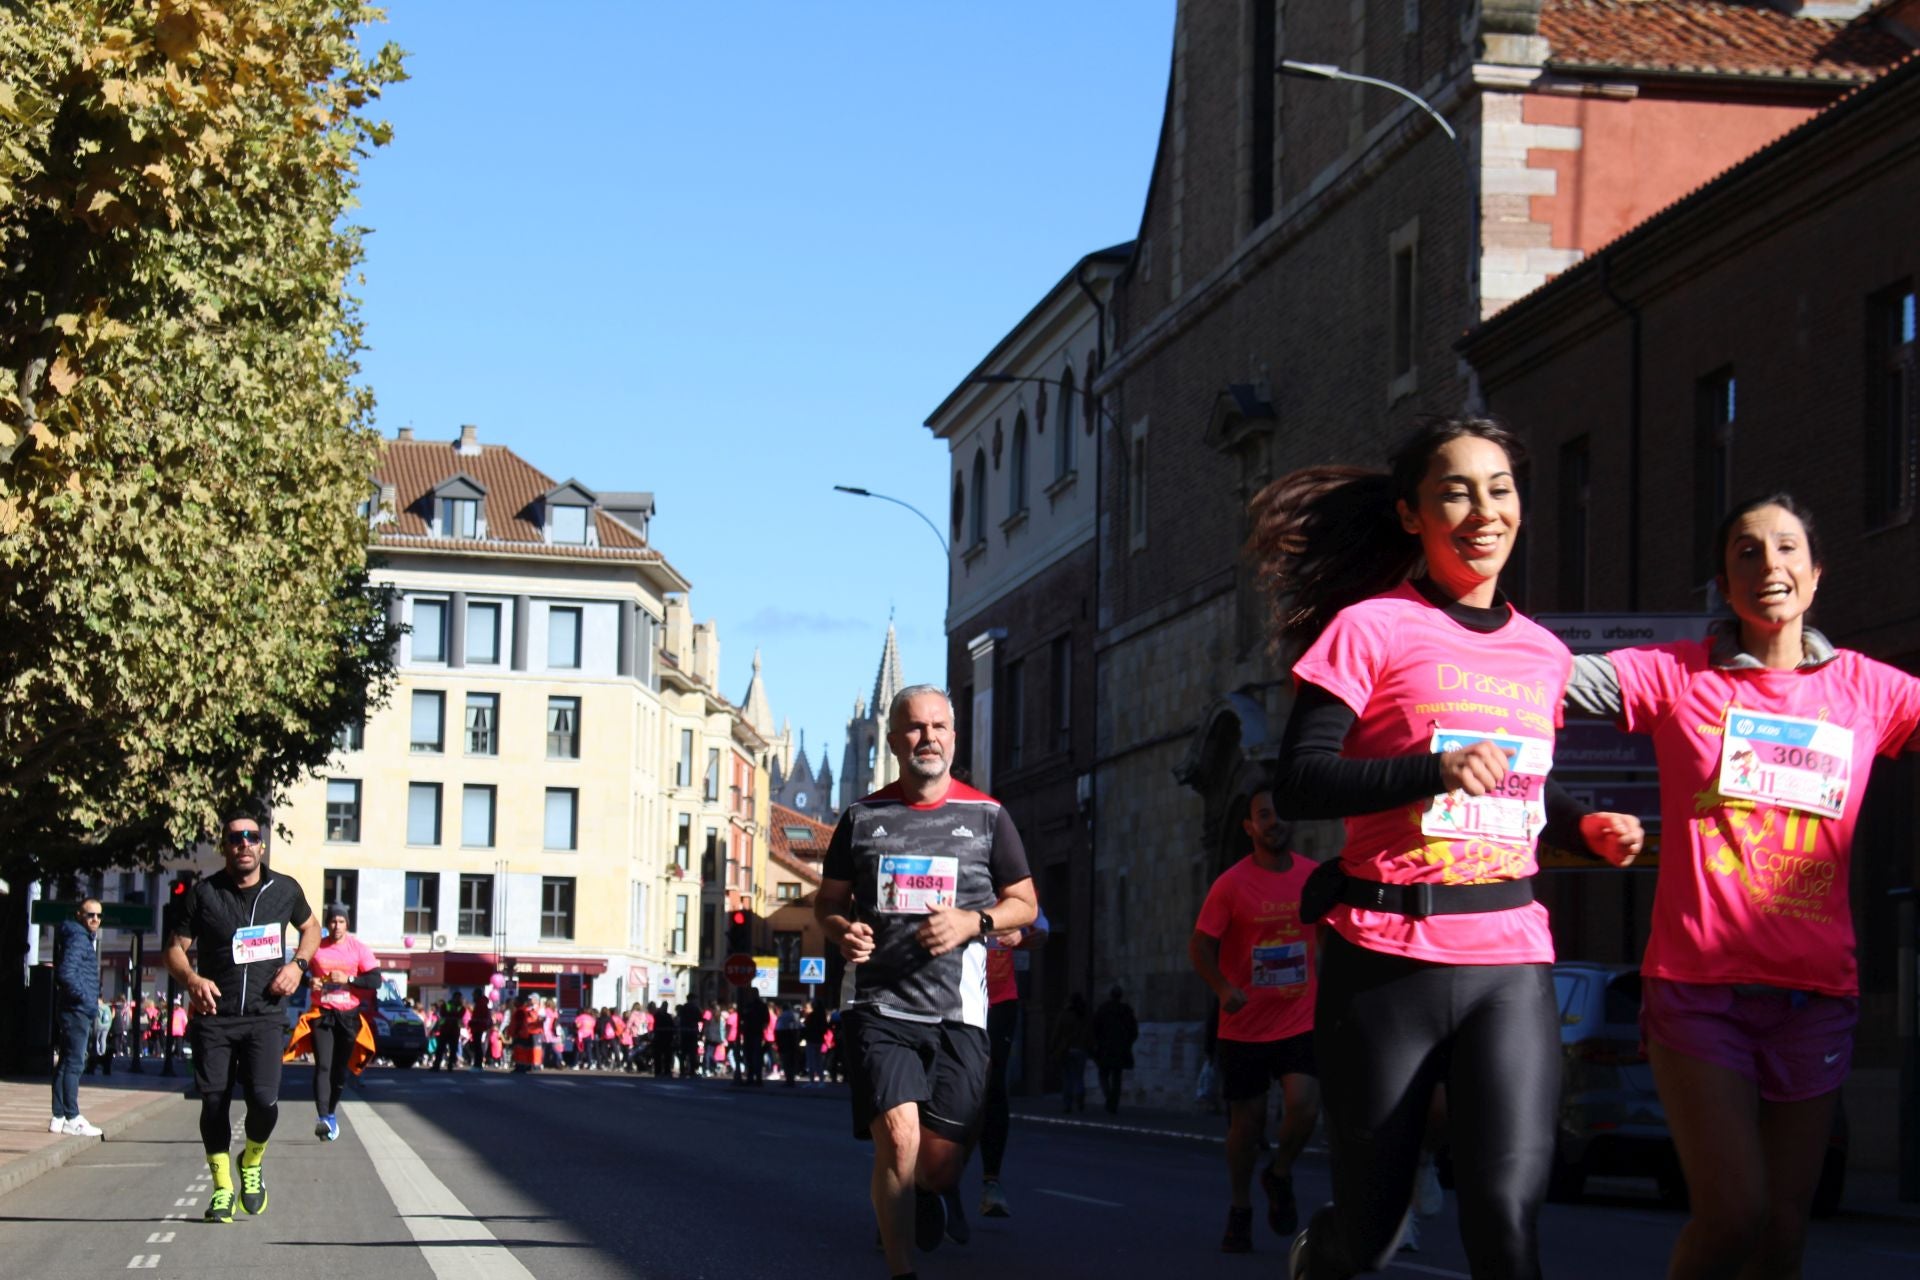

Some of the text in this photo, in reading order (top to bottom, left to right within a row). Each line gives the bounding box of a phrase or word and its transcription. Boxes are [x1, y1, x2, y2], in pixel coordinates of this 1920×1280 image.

[1602, 625, 1654, 640] urbano
[1437, 663, 1547, 708] Drasanvi
[1772, 746, 1833, 774] 3068
[1485, 774, 1531, 797] 499
[1760, 770, 1775, 793] 11
[1464, 802, 1480, 829] 11
[1752, 848, 1835, 880] Carrera
[906, 876, 944, 889] 4634
[1774, 874, 1832, 898] Mujer
[251, 937, 274, 946] 4356
[540, 964, 564, 974] KING
